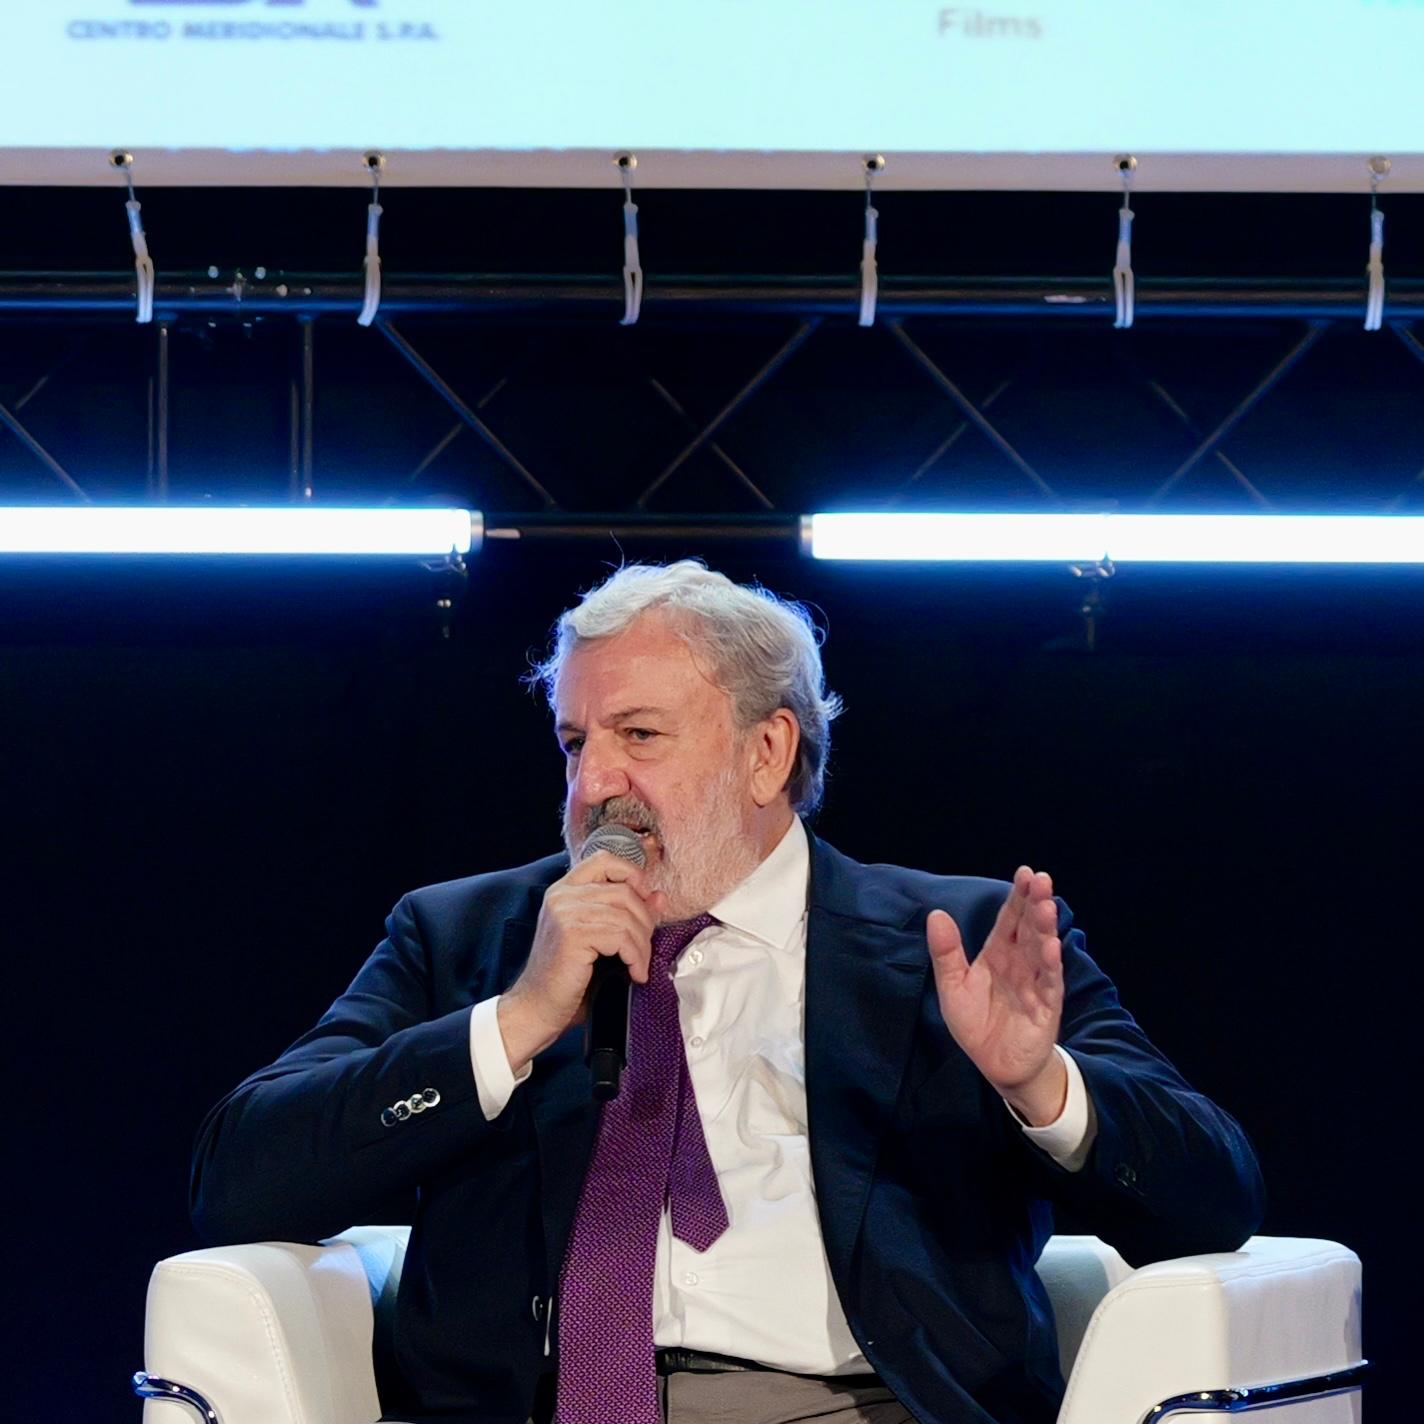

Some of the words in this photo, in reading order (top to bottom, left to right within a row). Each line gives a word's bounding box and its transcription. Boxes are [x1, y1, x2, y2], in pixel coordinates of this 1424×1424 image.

[66, 20, 173, 42] CENTRO
[180, 20, 367, 42] MERIDIONALE
[938, 8, 1043, 39] Films
